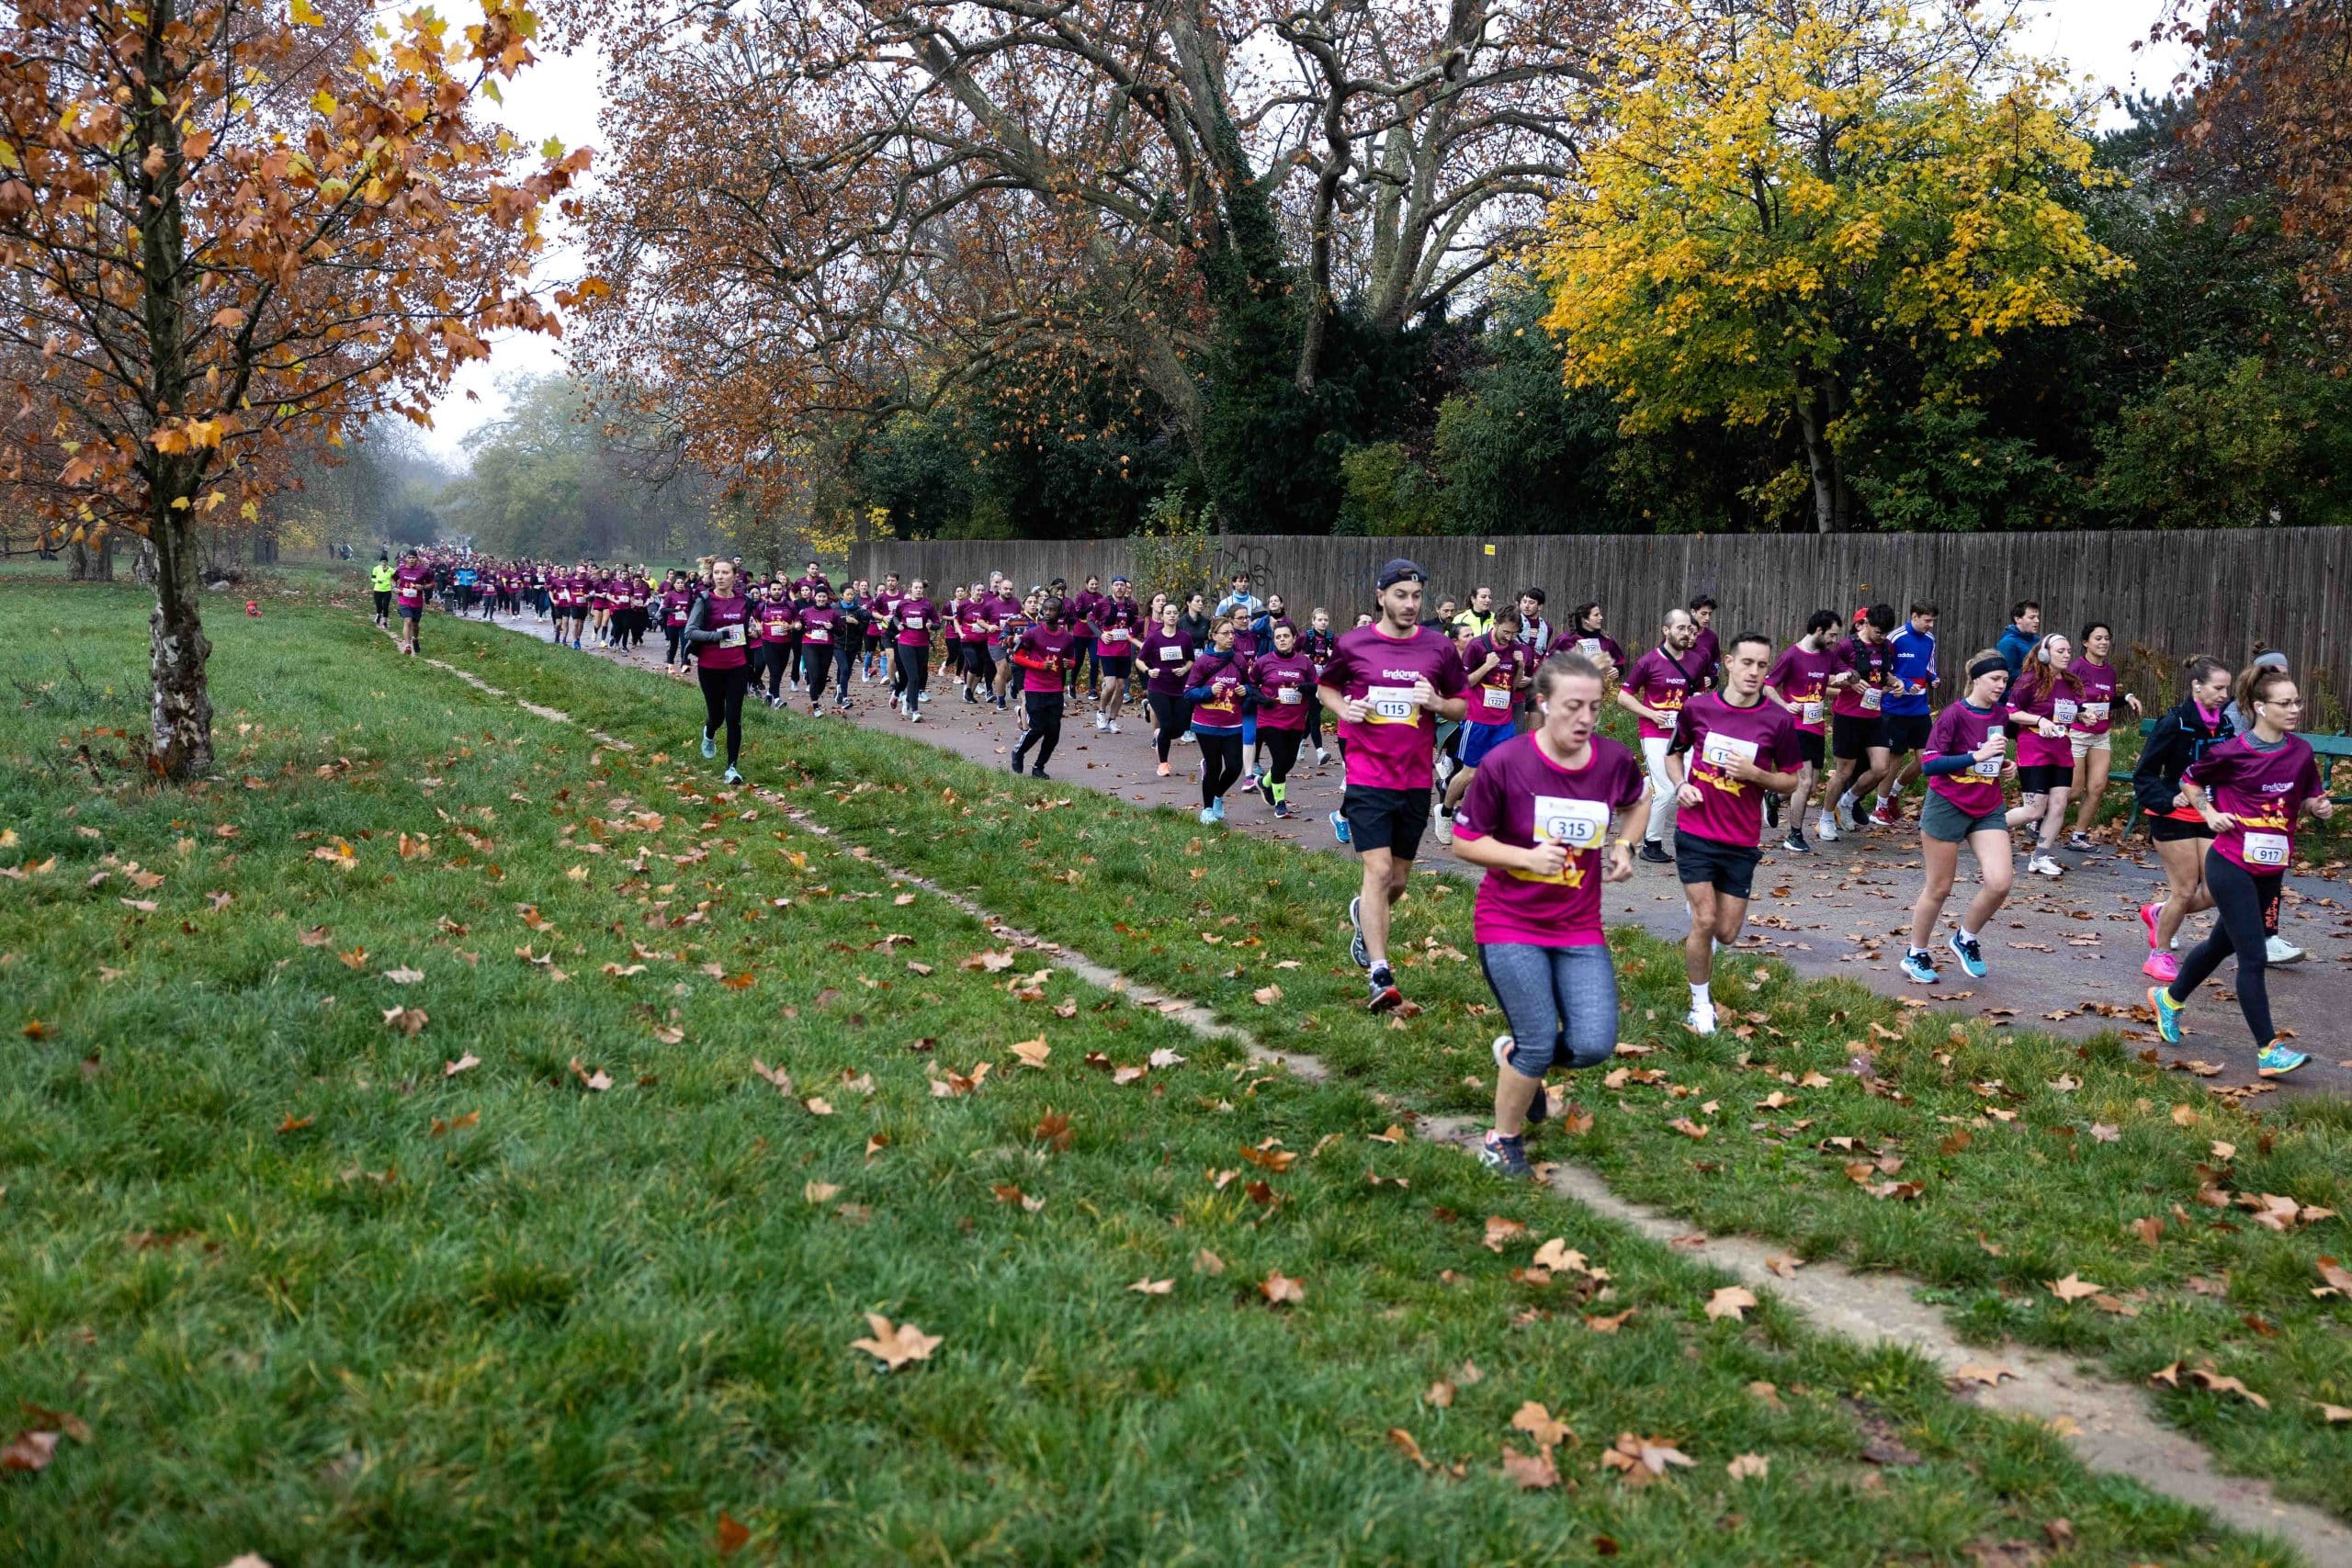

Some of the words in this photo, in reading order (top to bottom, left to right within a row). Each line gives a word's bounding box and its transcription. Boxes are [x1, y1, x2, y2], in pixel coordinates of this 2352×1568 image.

[1384, 704, 1405, 715] 115
[1983, 763, 1994, 773] 23
[1558, 821, 1586, 837] 315
[2260, 850, 2279, 861] 917
